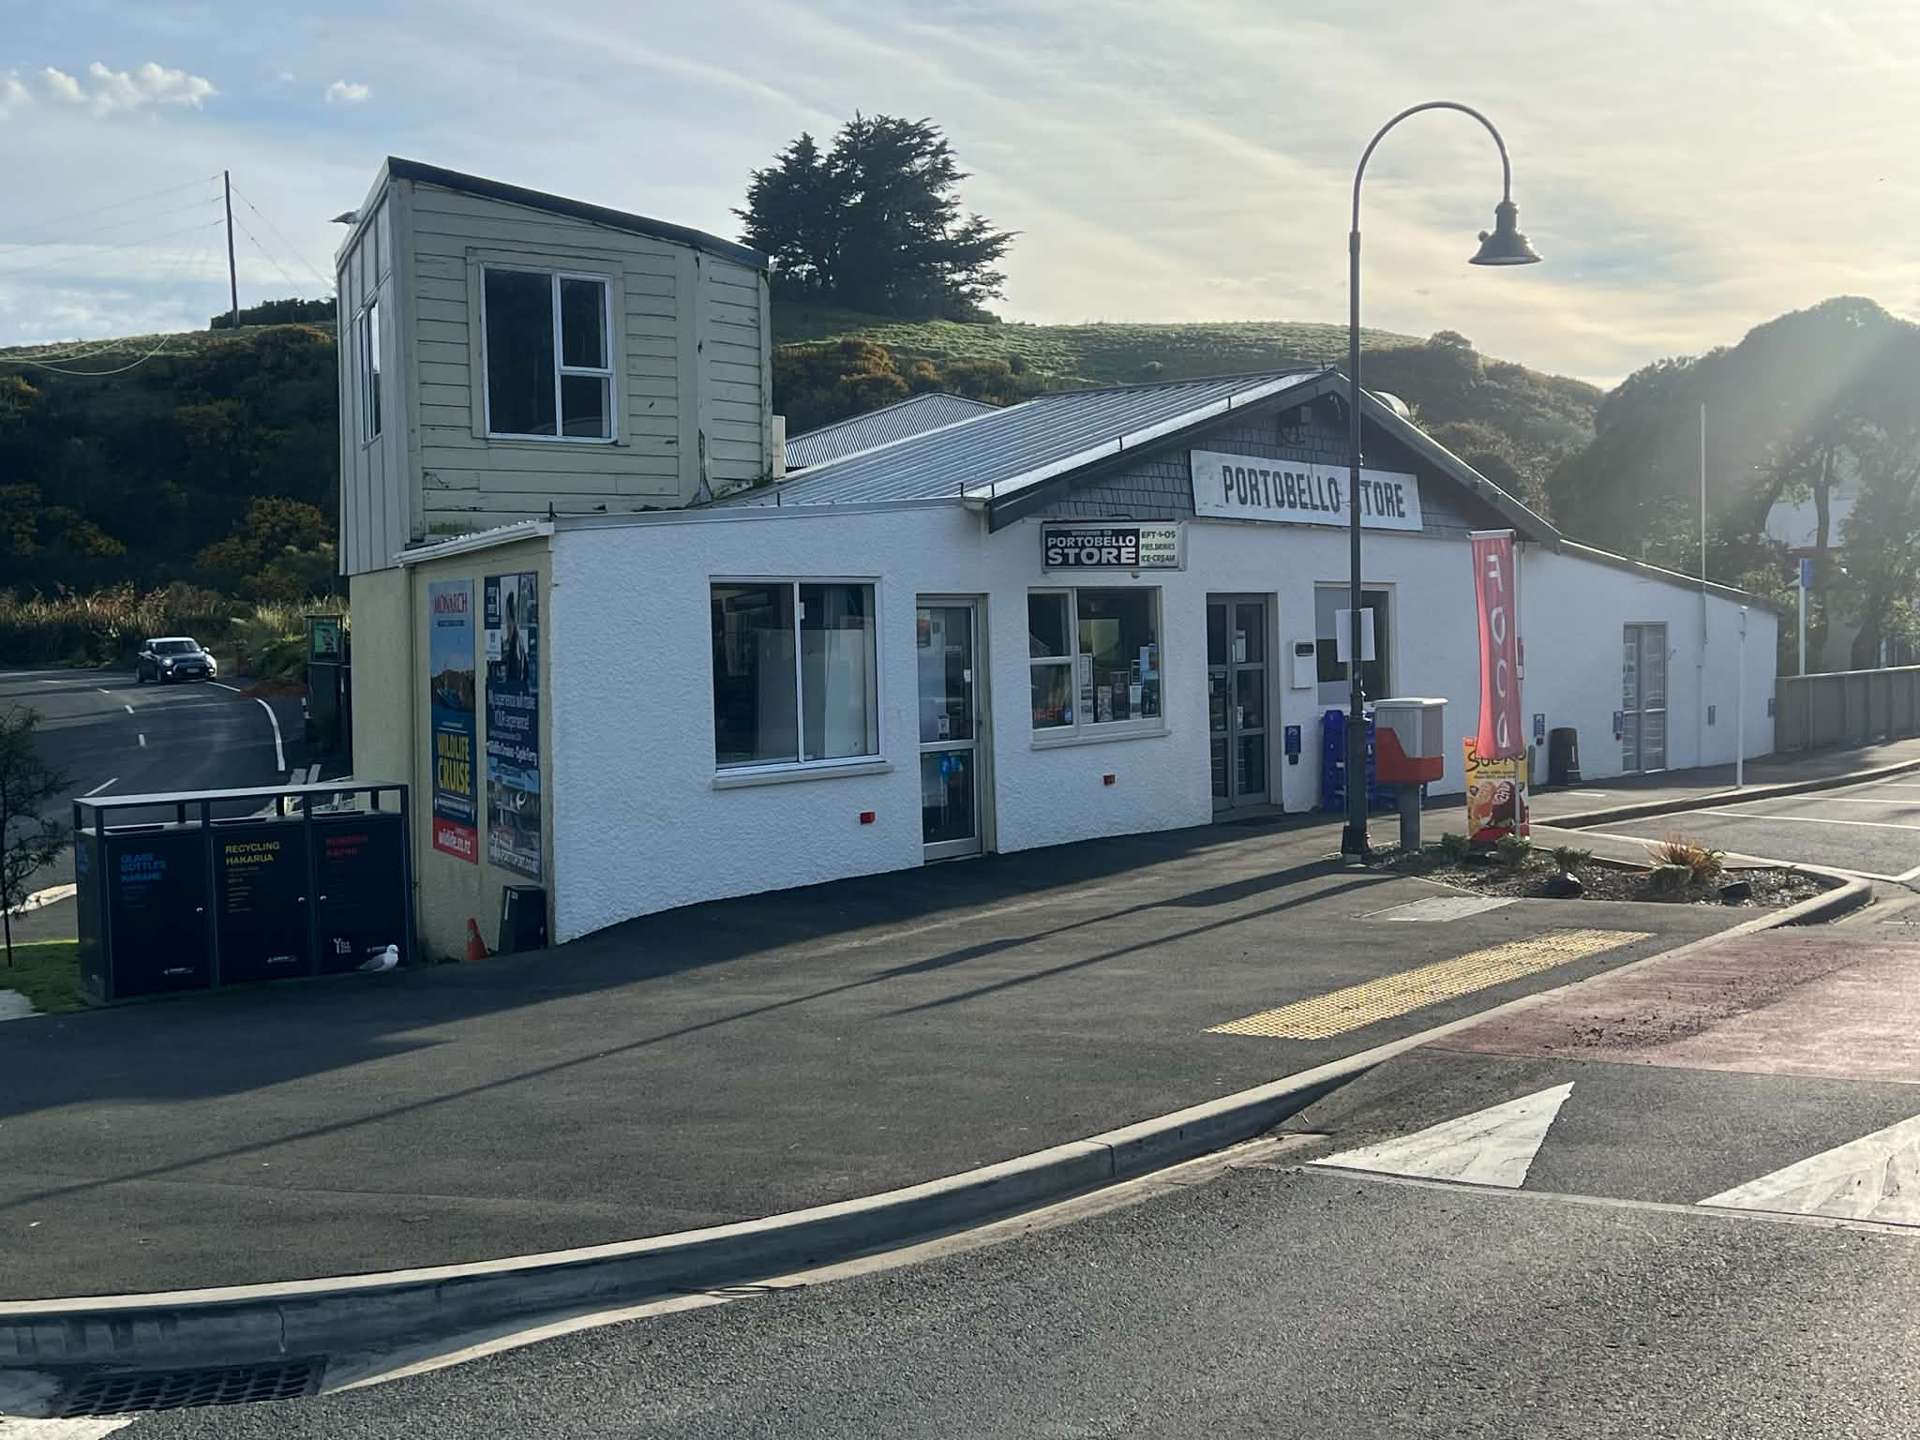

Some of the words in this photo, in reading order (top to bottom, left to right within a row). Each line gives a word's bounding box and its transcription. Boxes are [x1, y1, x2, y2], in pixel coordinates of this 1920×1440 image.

[1222, 464, 1341, 513] PORTOBELLO
[1355, 478, 1406, 518] TORE
[1047, 535, 1136, 548] PORTOBELLO
[1047, 547, 1136, 565] STORE
[437, 733, 470, 762] WILDLIFE
[438, 757, 471, 796] CRUISE
[225, 841, 281, 855] RECYCLING
